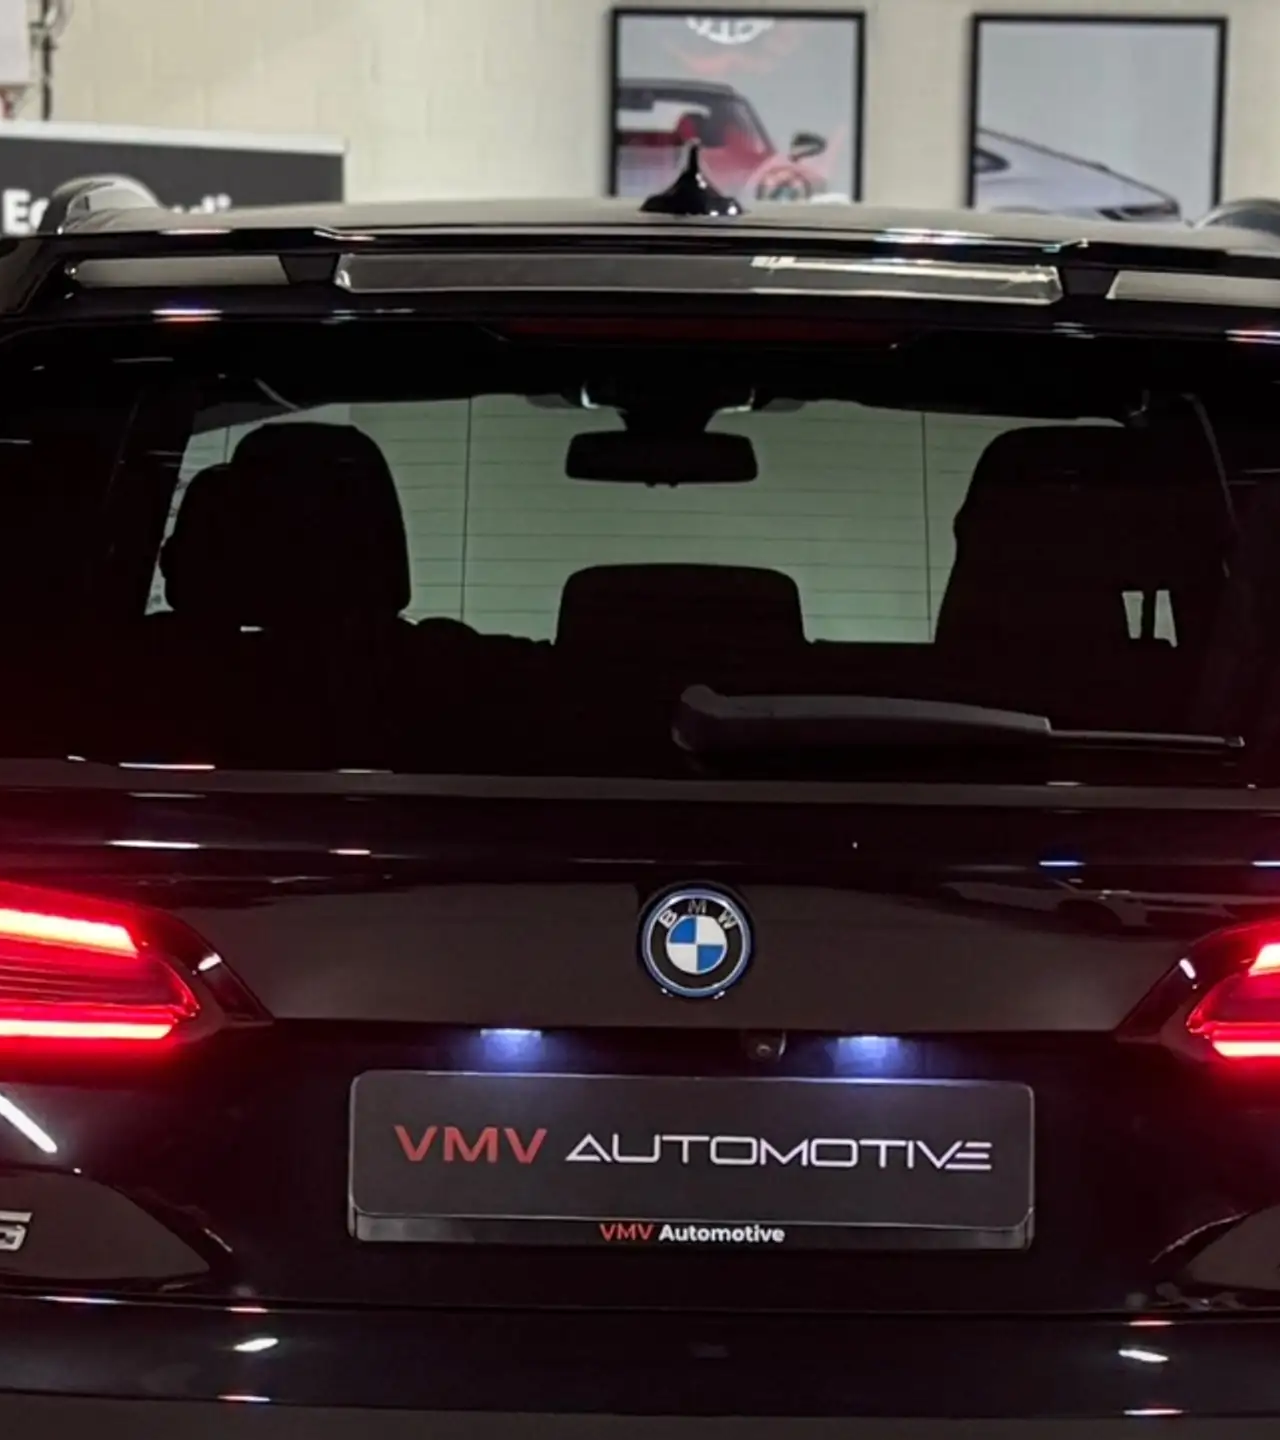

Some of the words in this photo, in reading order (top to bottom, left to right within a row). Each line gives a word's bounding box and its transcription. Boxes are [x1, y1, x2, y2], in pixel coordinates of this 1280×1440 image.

[658, 898, 739, 929] BMW
[394, 1125, 546, 1163] VMV
[565, 1133, 992, 1170] AUTOMOTIVE
[599, 1225, 653, 1242] VMV
[659, 1225, 785, 1244] Automotive
